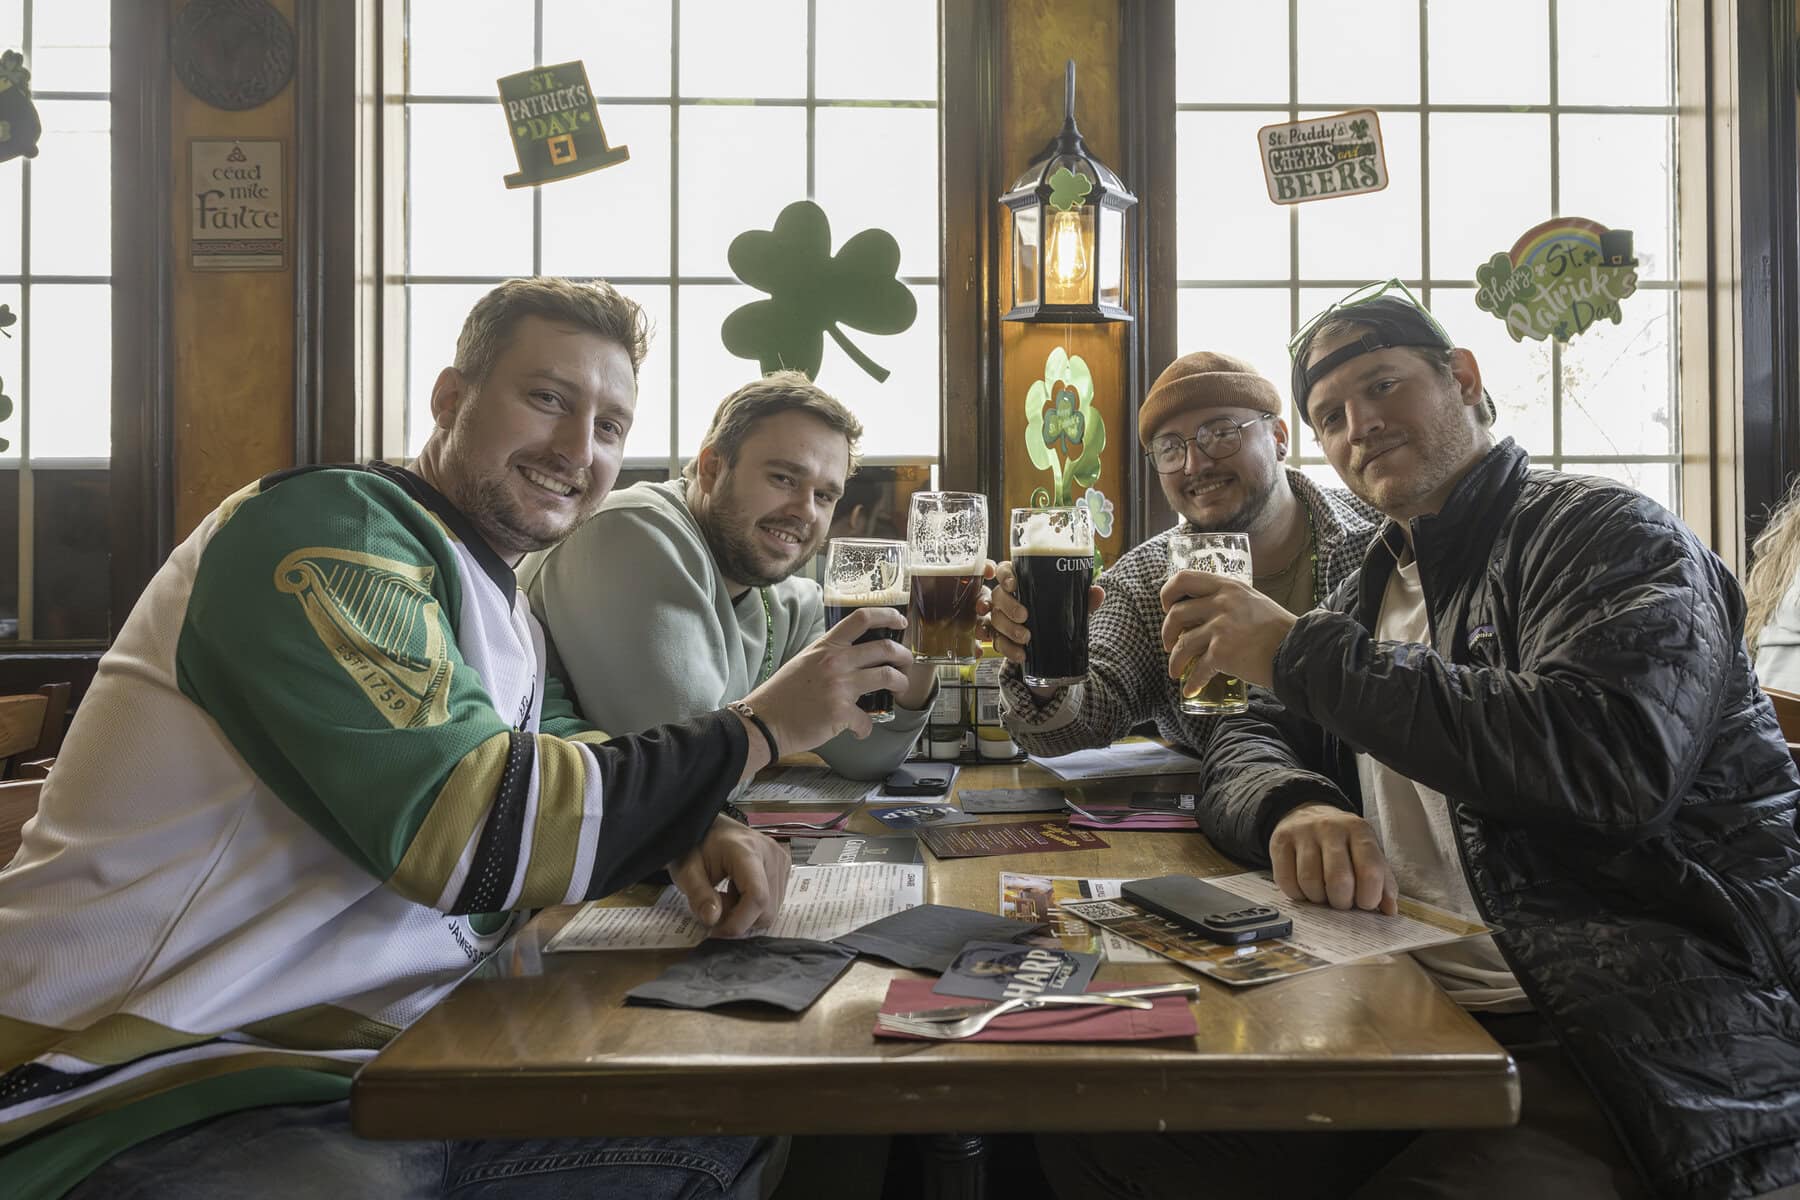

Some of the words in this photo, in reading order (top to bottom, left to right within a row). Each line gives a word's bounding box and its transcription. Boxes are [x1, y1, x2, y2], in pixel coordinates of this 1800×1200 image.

[526, 109, 579, 139] DAY
[1289, 122, 1348, 143] Paddy's
[1269, 143, 1336, 174] CHEERS
[1274, 157, 1379, 201] BEERS
[1546, 243, 1582, 277] St.
[1479, 270, 1530, 309] Happy
[1507, 264, 1637, 342] Patrick's
[1571, 299, 1621, 333] Day
[1002, 948, 1062, 998] HARP
